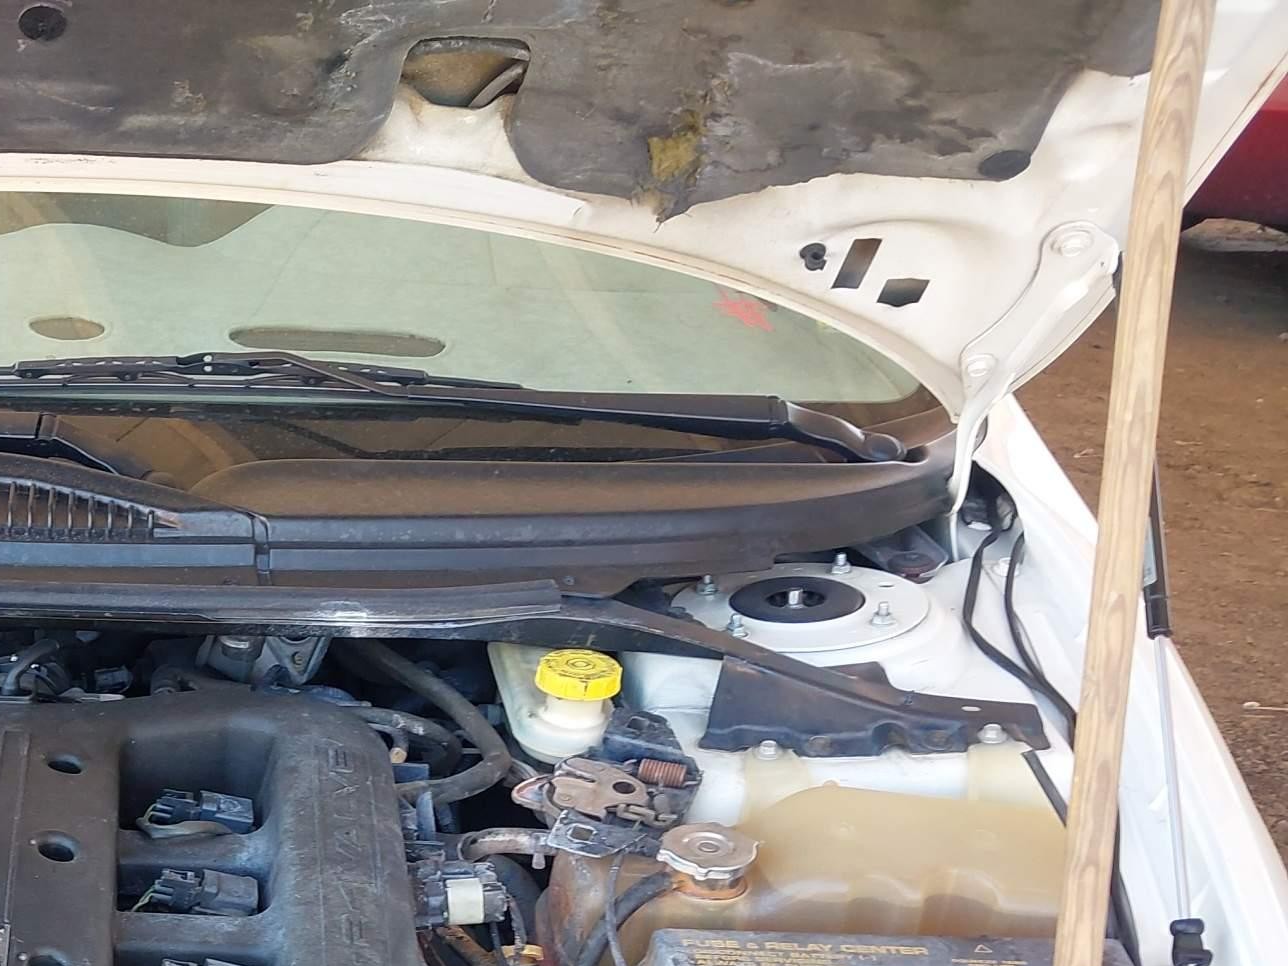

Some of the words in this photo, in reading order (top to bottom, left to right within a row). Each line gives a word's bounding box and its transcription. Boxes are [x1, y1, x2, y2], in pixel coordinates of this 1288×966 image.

[682, 939, 740, 949] FUSE
[764, 941, 832, 952] RELAY
[840, 944, 929, 956] CENTER
